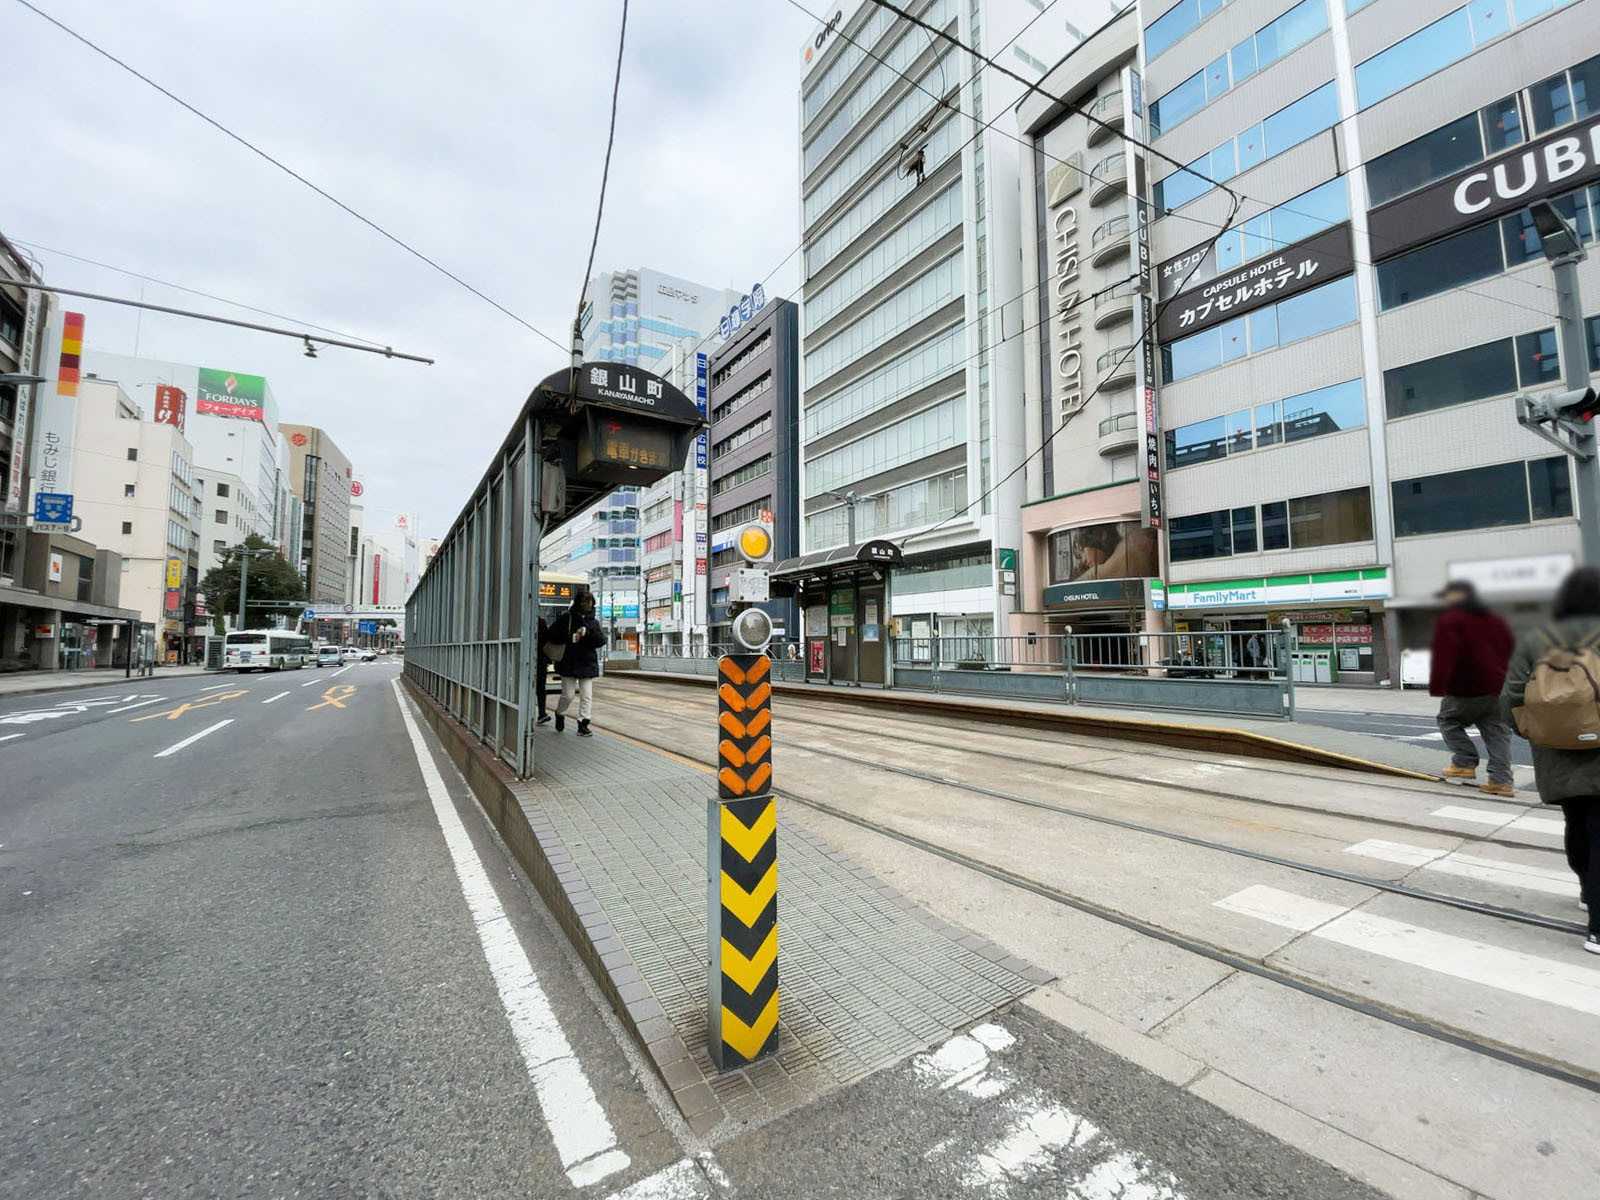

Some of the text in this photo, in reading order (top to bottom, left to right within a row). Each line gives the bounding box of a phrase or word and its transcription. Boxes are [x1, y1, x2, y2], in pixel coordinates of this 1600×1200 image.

[1138, 210, 1149, 280] CUBE
[1054, 206, 1081, 324] CHISUN
[1203, 256, 1287, 298] CAPSULE HOTEL
[1179, 259, 1319, 328] カプセルホテル
[590, 367, 663, 399] 銀山町
[1058, 324, 1085, 426] HOTEL
[203, 403, 257, 416] フォーデイズ
[206, 393, 258, 407] FORDAYS
[597, 388, 655, 405] KANAYAMACHO
[1063, 594, 1080, 602] CHISUN
[1193, 590, 1256, 605] FamilyMart
